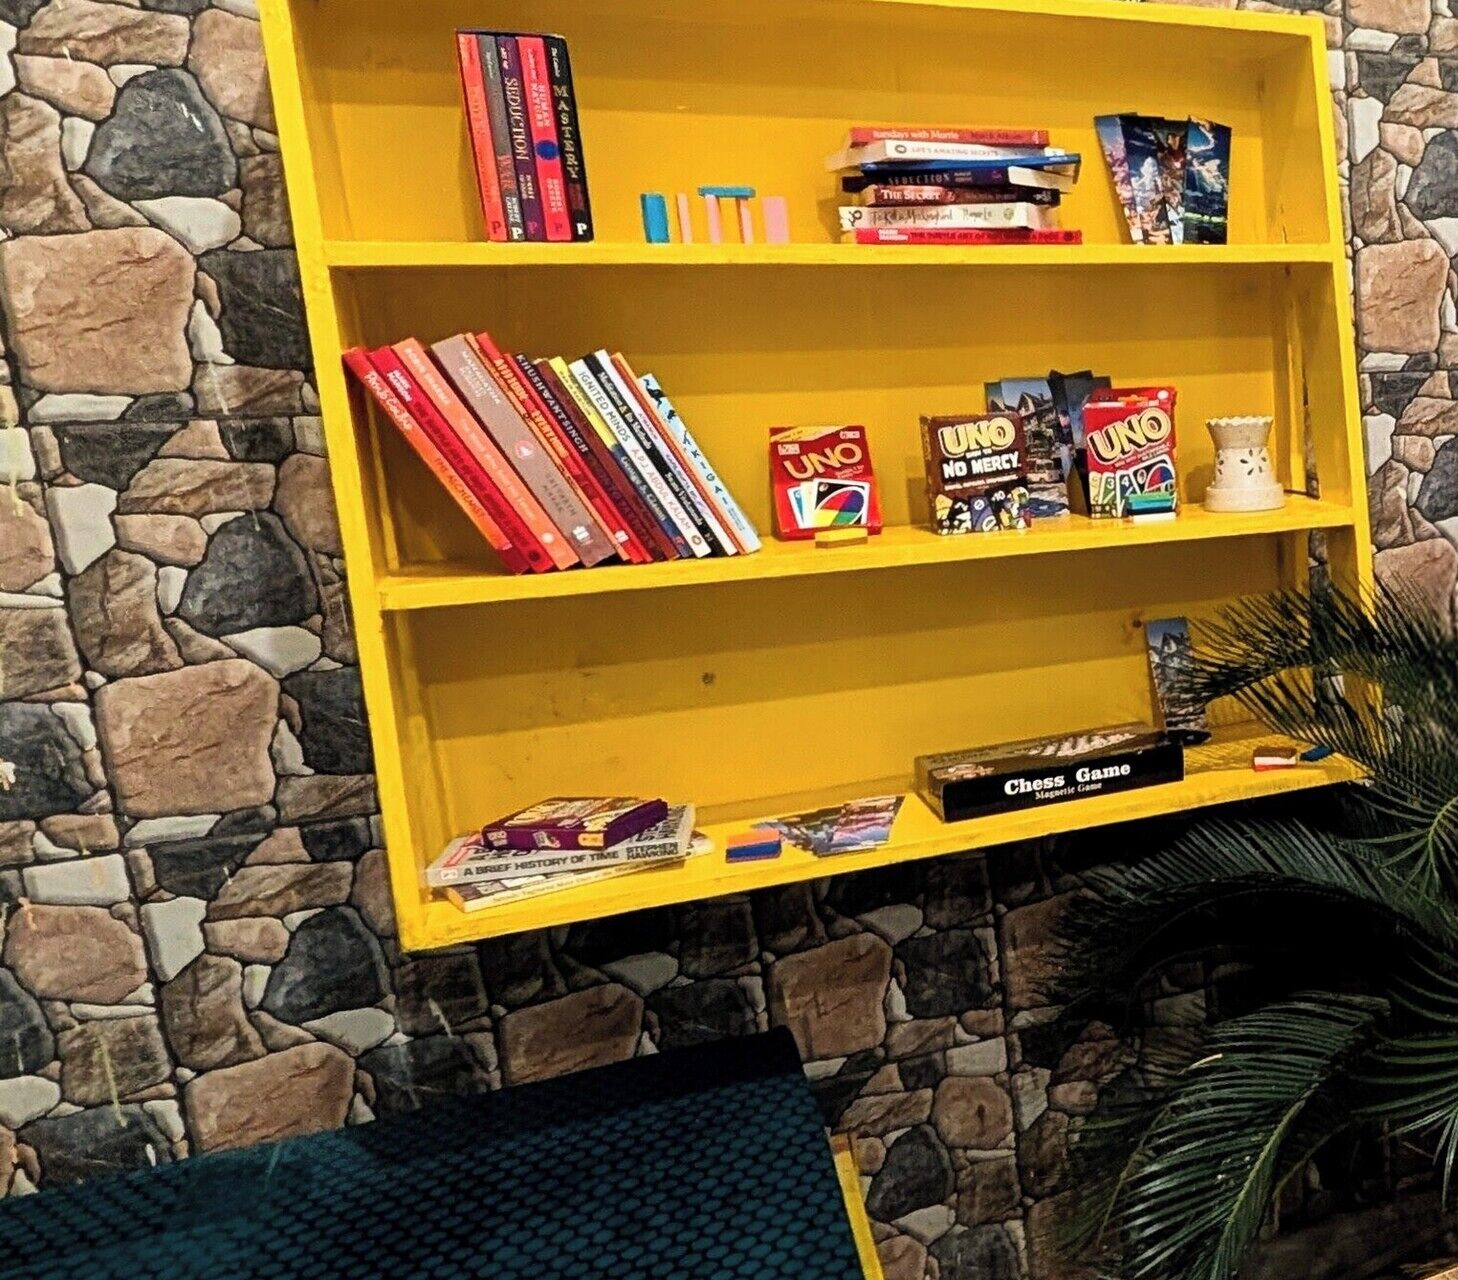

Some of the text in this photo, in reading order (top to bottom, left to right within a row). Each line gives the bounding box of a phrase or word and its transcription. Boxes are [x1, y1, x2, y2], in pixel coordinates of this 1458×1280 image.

[880, 189, 903, 200] THE
[579, 371, 609, 410] IGNITED
[606, 409, 632, 442] MINDS
[939, 417, 1016, 458] UNO
[1087, 406, 1171, 465] UNO
[783, 442, 863, 480] UNO
[942, 460, 968, 479] NO
[668, 499, 692, 531] KALAM
[1004, 763, 1131, 796] Chess Game
[1035, 782, 1103, 801] Magnetic Game
[626, 841, 679, 855] STEPHEN
[626, 848, 679, 861] HAWKING
[463, 850, 619, 877] A BRIEF HISTORY OF TIME
